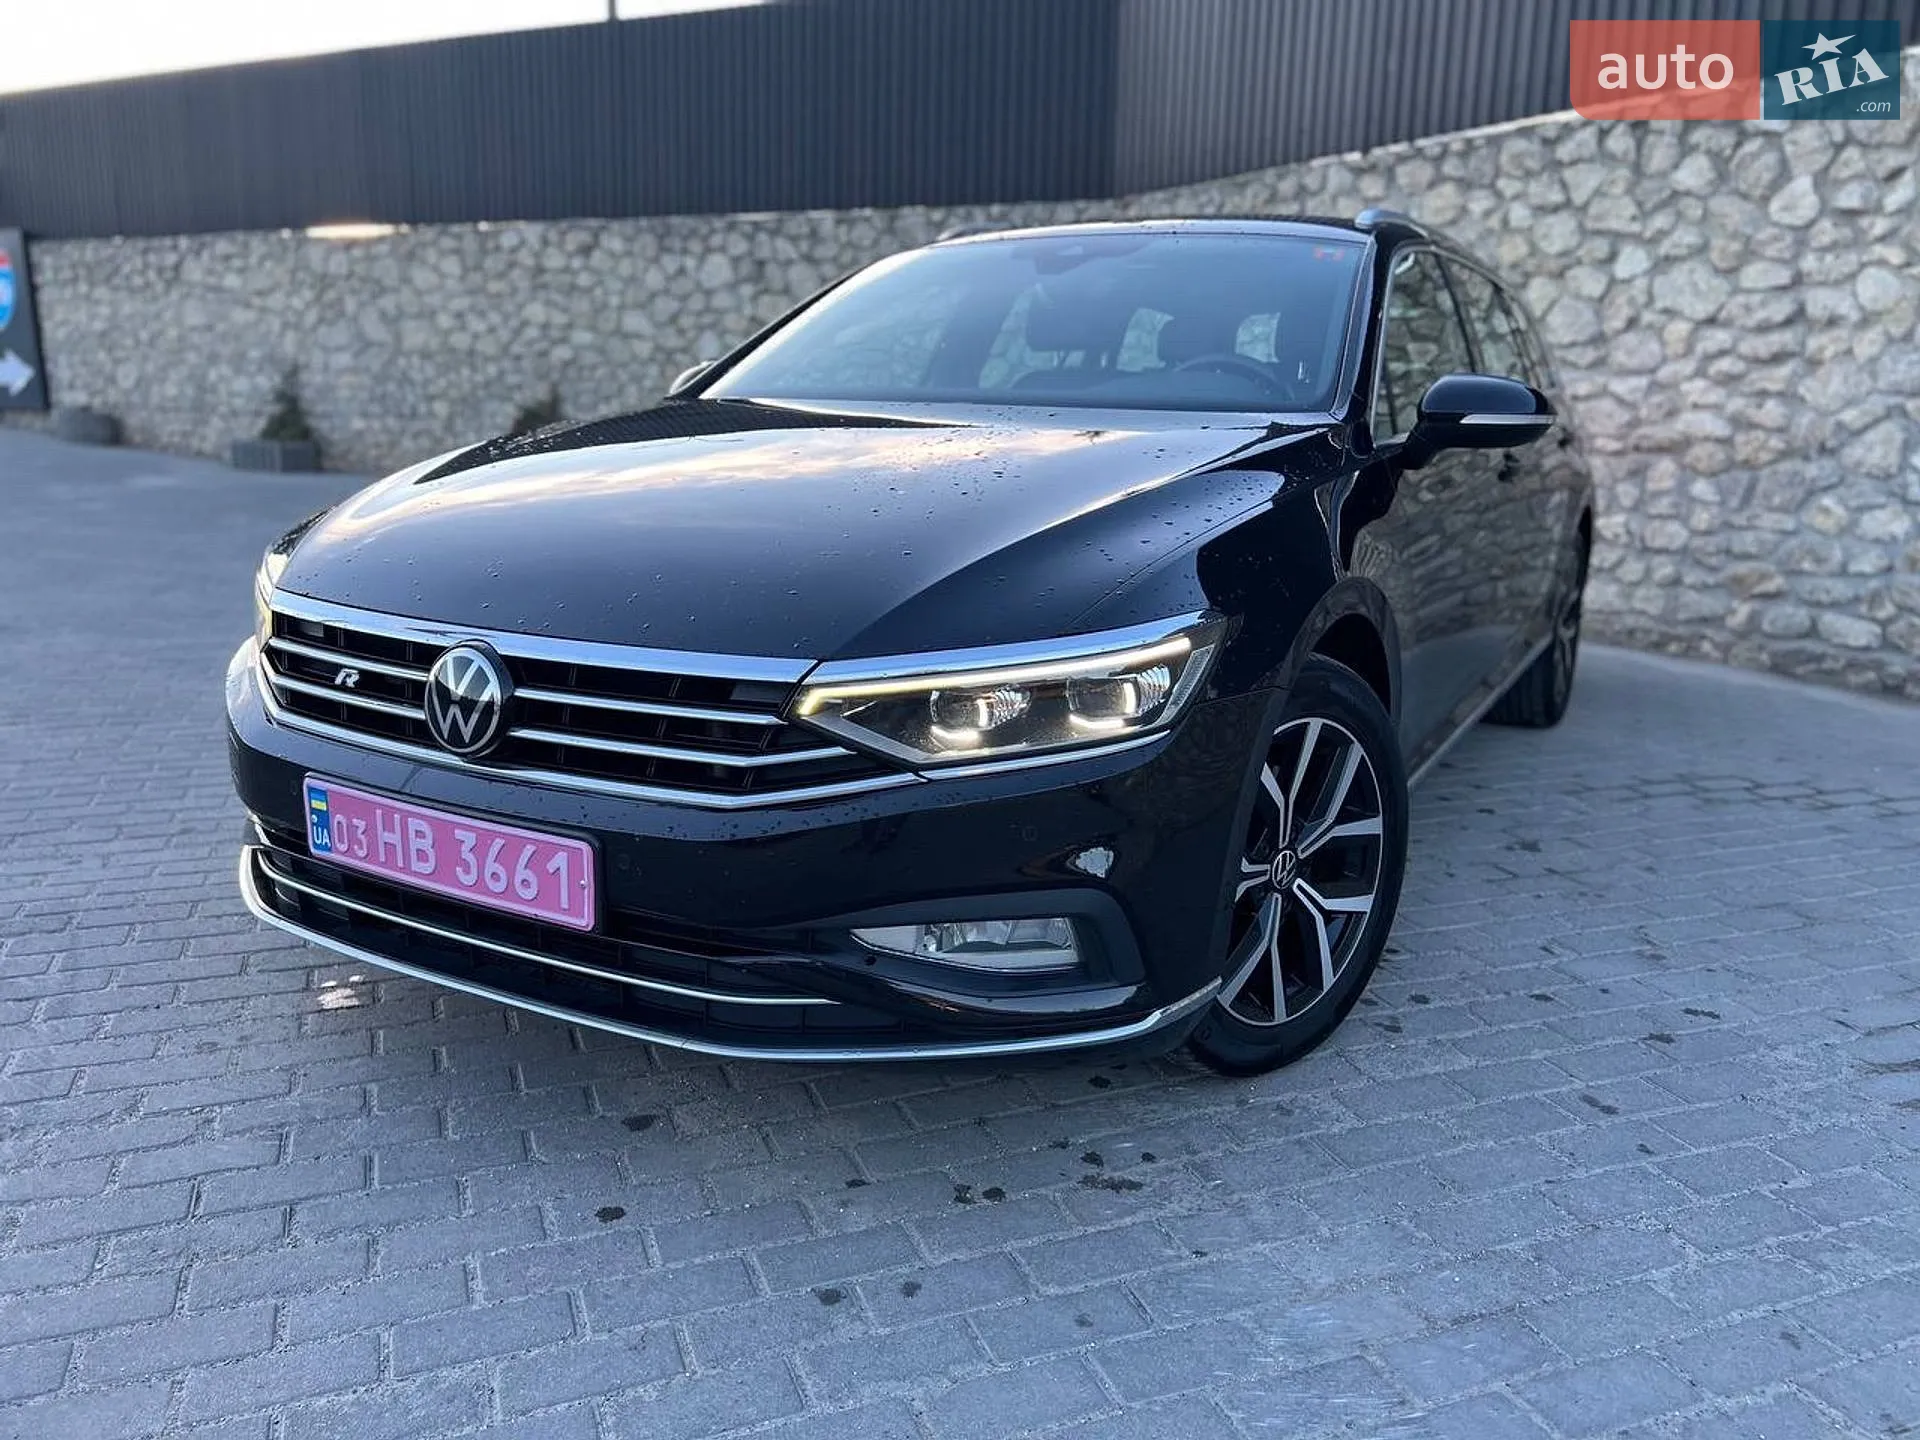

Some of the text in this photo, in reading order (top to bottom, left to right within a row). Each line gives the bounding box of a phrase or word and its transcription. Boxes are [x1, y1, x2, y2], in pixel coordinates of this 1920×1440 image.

[334, 667, 360, 689] R
[313, 825, 331, 848] UA
[334, 808, 570, 911] 03 HB 3661
